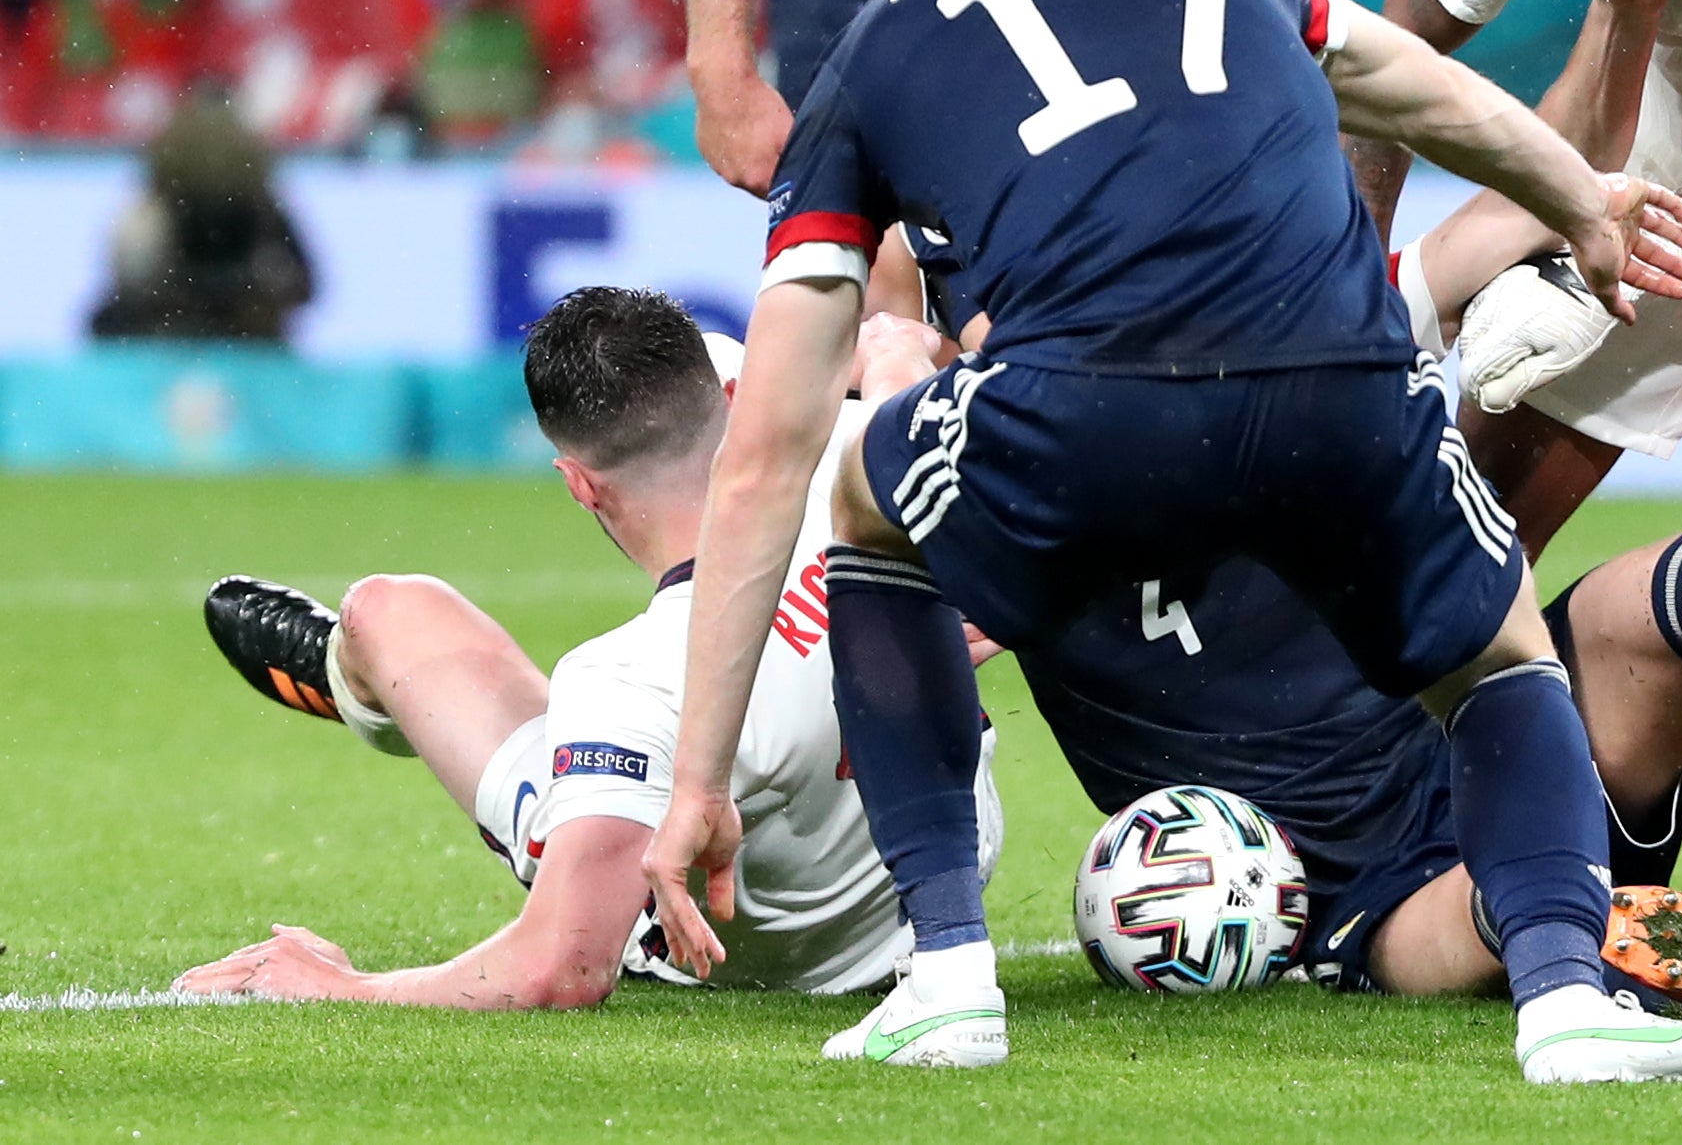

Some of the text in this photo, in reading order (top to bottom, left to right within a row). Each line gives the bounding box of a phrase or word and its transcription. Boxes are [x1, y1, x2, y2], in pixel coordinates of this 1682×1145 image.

[772, 551, 832, 659] RIC
[1142, 579, 1203, 656] 4
[572, 751, 647, 774] RESPECT
